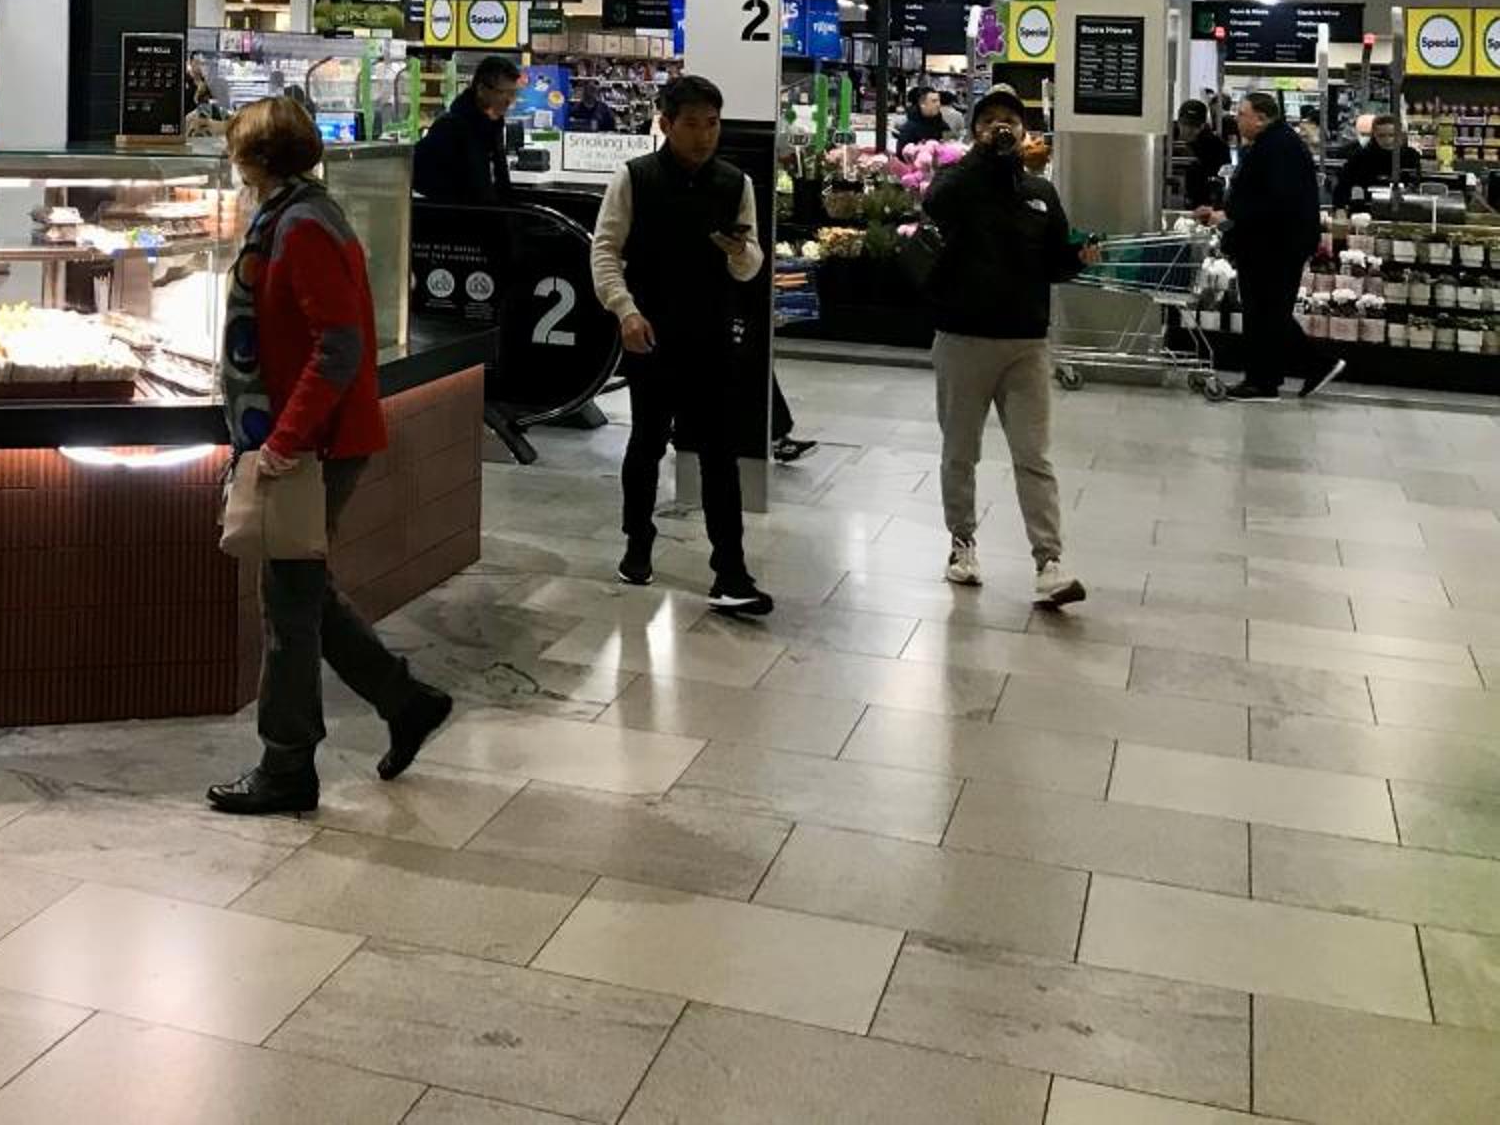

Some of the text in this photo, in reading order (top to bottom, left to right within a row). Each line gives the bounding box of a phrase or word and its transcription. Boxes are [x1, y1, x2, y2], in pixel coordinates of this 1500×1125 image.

[471, 14, 505, 25] Special
[1020, 27, 1049, 38] Special
[1081, 25, 1133, 35] Store Hours
[1421, 37, 1459, 50] Special
[569, 135, 650, 151] Smoking kills
[532, 276, 575, 346] 2
